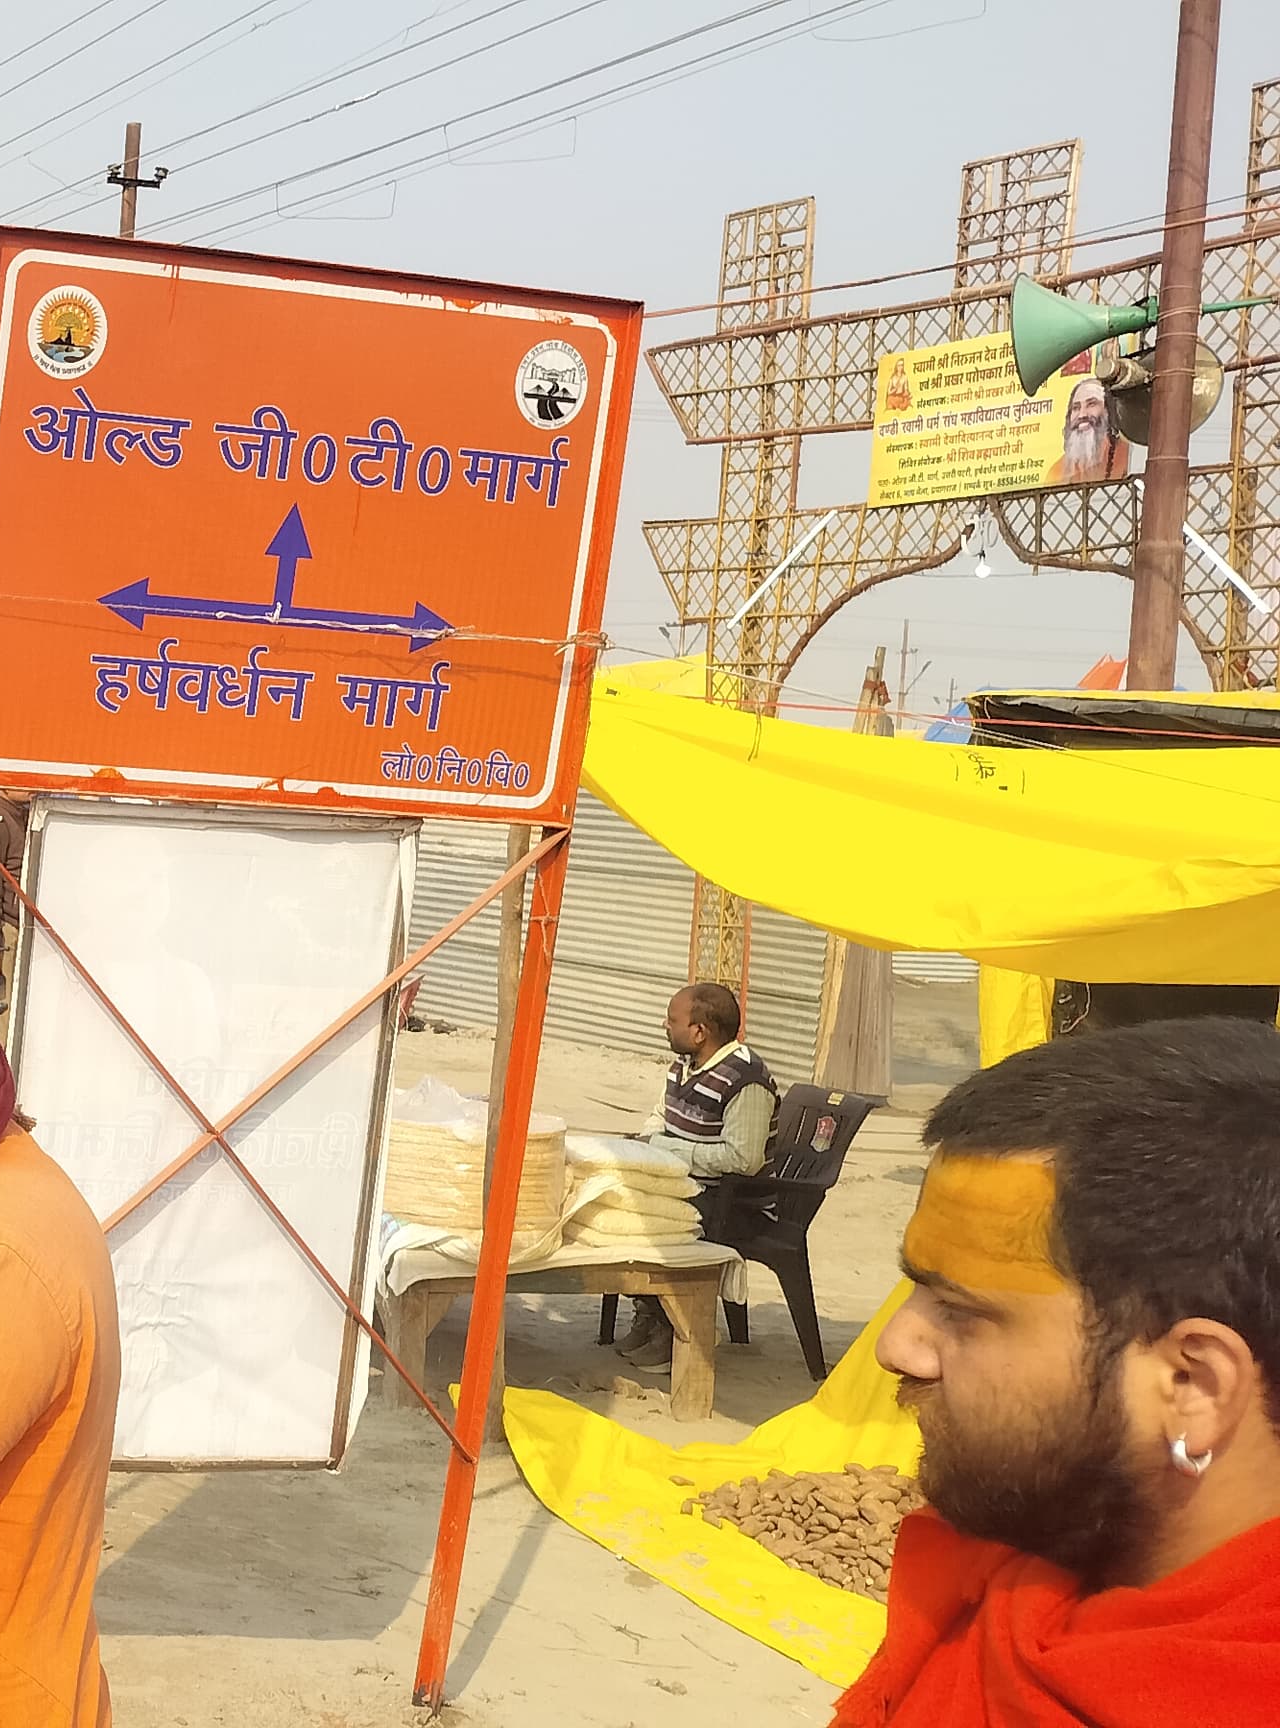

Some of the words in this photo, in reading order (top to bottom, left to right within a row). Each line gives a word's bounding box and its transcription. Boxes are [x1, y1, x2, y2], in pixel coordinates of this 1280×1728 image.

[913, 356, 935, 374] स्वामी
[937, 353, 948, 370] श्री
[985, 347, 996, 362] देव
[930, 372, 943, 389] श्री
[944, 371, 964, 388] प्रखर
[966, 364, 1003, 384] परोपकार
[951, 388, 974, 405] स्वामी
[974, 386, 985, 402] श्री
[1004, 380, 1016, 395] जी
[960, 405, 1010, 426] महाविद्यालय
[1013, 398, 1053, 424] लुधियाना
[24, 387, 190, 469] ओल्ड
[996, 424, 1007, 439] जी
[1008, 422, 1040, 437] महाराज
[946, 448, 957, 465] श्री
[1011, 440, 1024, 455] जी
[90, 637, 313, 722] हर्षवर्धन
[337, 661, 450, 732] मार्ग
